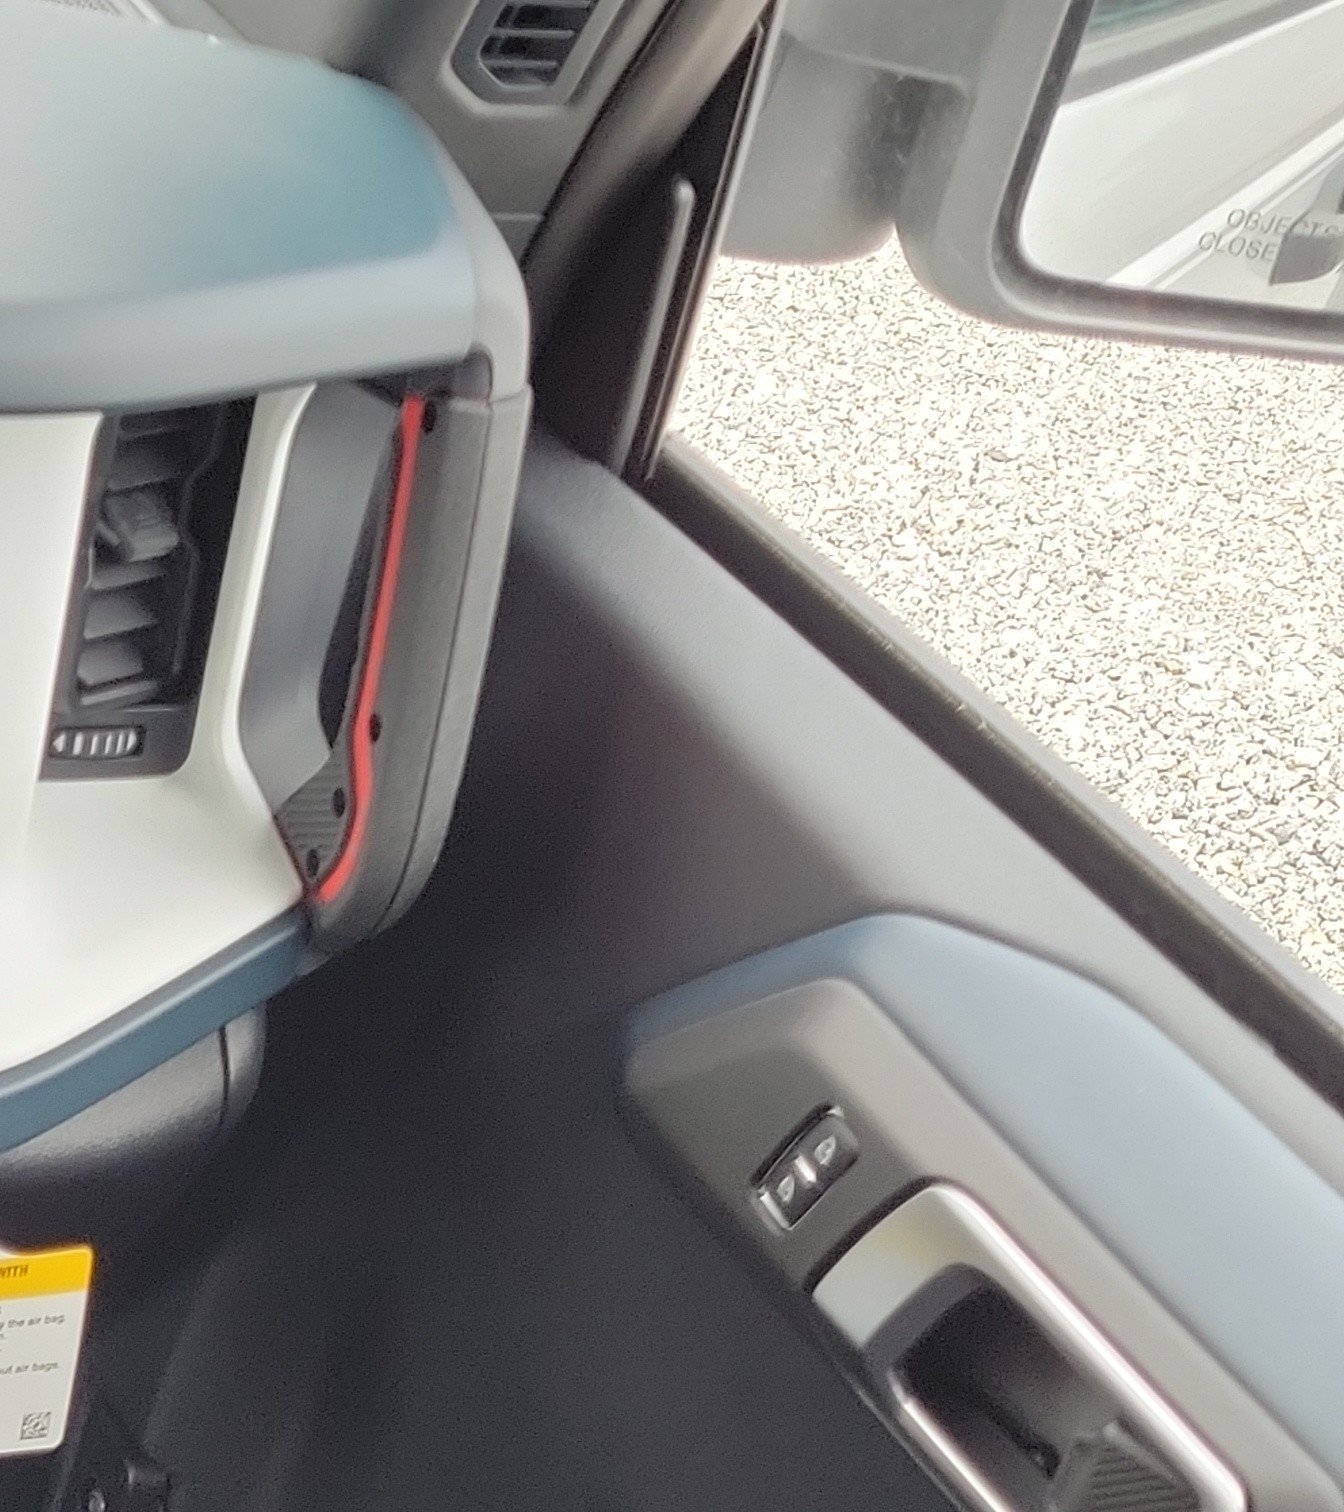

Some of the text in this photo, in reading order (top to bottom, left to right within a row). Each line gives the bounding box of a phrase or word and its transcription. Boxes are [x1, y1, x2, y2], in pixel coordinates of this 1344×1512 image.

[8, 1319, 25, 1328] the
[27, 1317, 41, 1326] air
[15, 1363, 29, 1373] air
